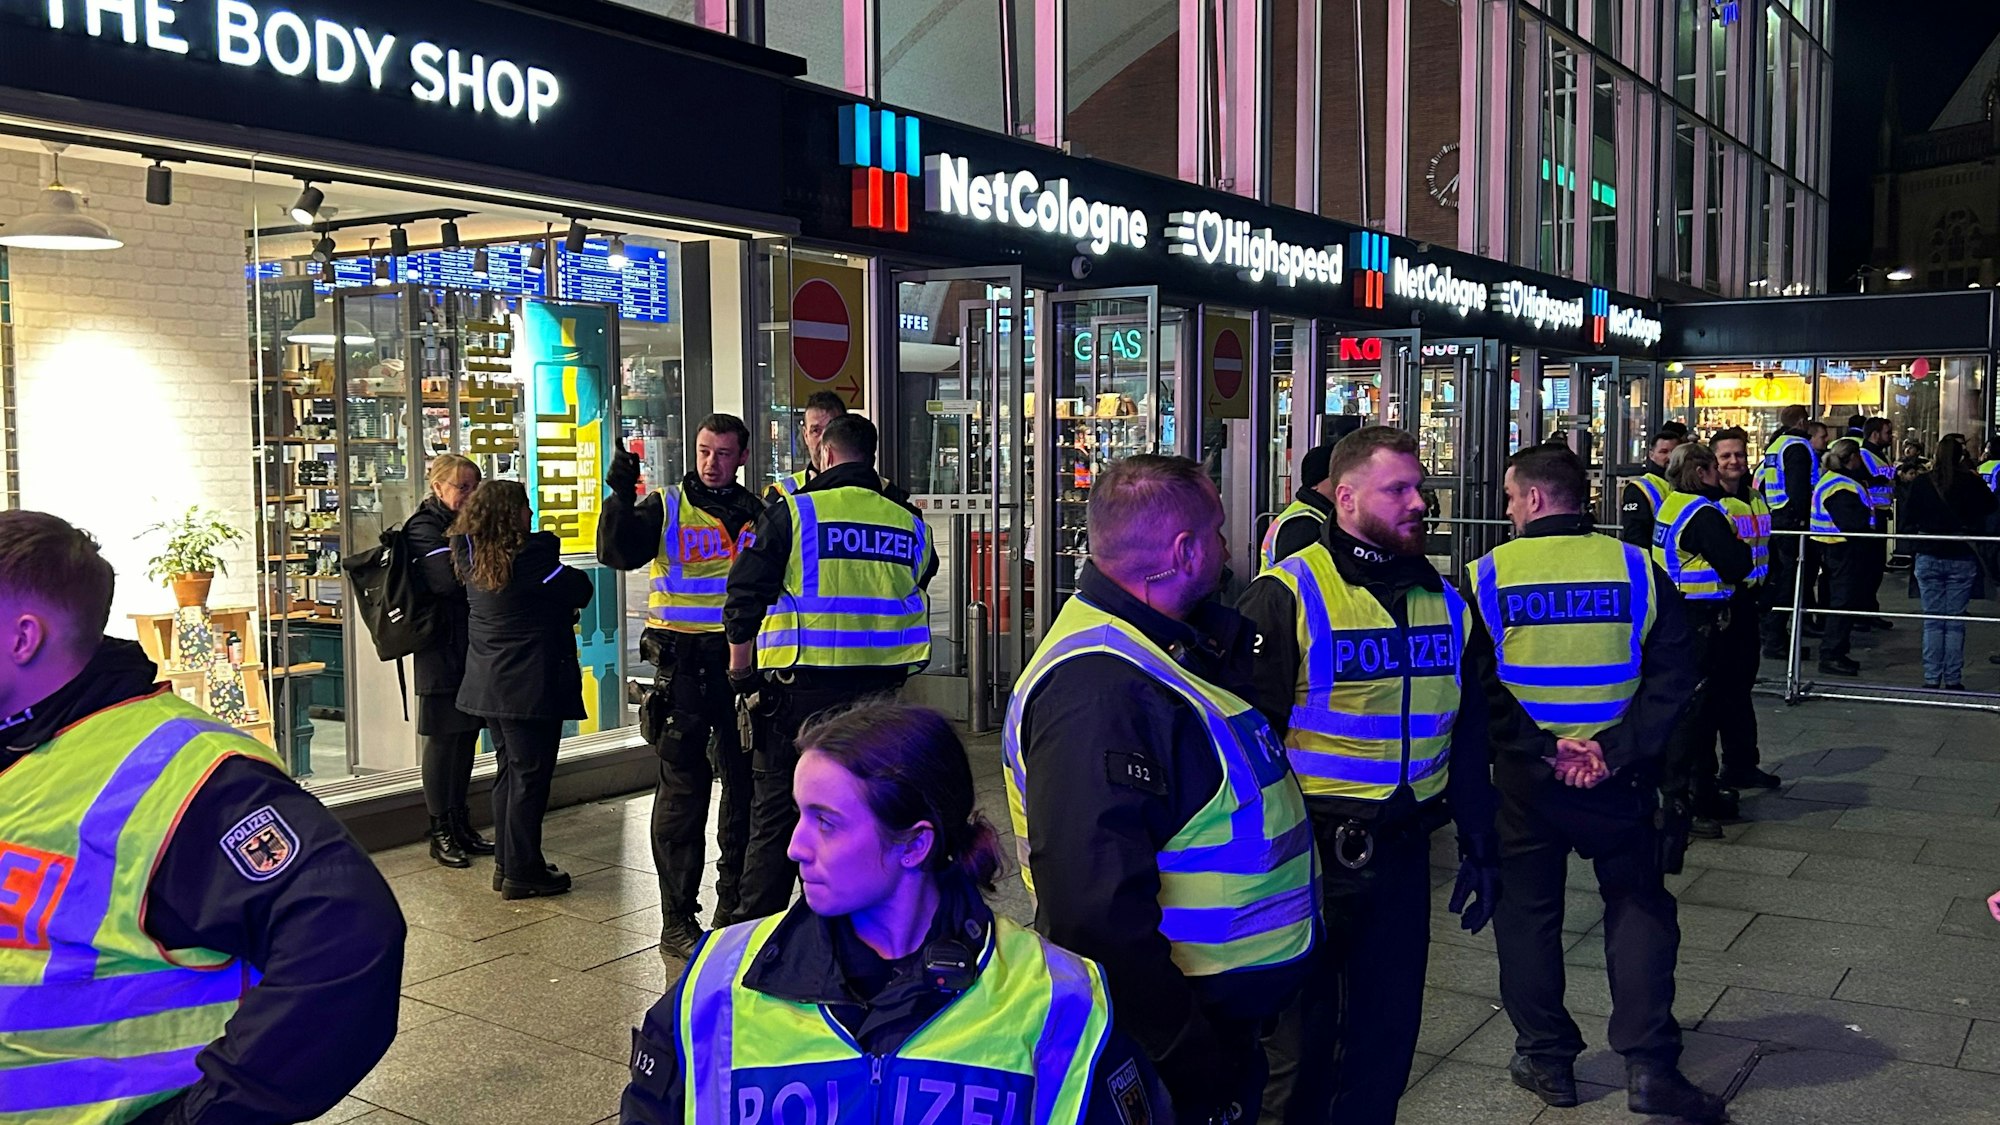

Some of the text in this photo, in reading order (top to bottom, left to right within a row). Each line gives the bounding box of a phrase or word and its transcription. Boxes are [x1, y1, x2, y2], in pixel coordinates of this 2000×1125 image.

[217, 0, 396, 90] BODY
[410, 41, 559, 124] SHOP
[938, 152, 1343, 287] NetCologne Highspeed
[1393, 255, 1584, 331] NetCologne Highspeed
[1608, 303, 1662, 348] NetCologne
[465, 312, 514, 454] REFILL
[1693, 384, 1752, 399] Kamps
[536, 403, 579, 538] REFILL
[1622, 502, 1639, 512] 432
[827, 526, 913, 560] POLIZEI
[1505, 588, 1620, 622] POLIZEI
[1335, 632, 1454, 673] POLIZEI
[1127, 763, 1151, 782] 132
[225, 810, 275, 850] POLIZEI
[634, 1050, 656, 1077] 132
[1110, 1063, 1137, 1096] POLIZEI
